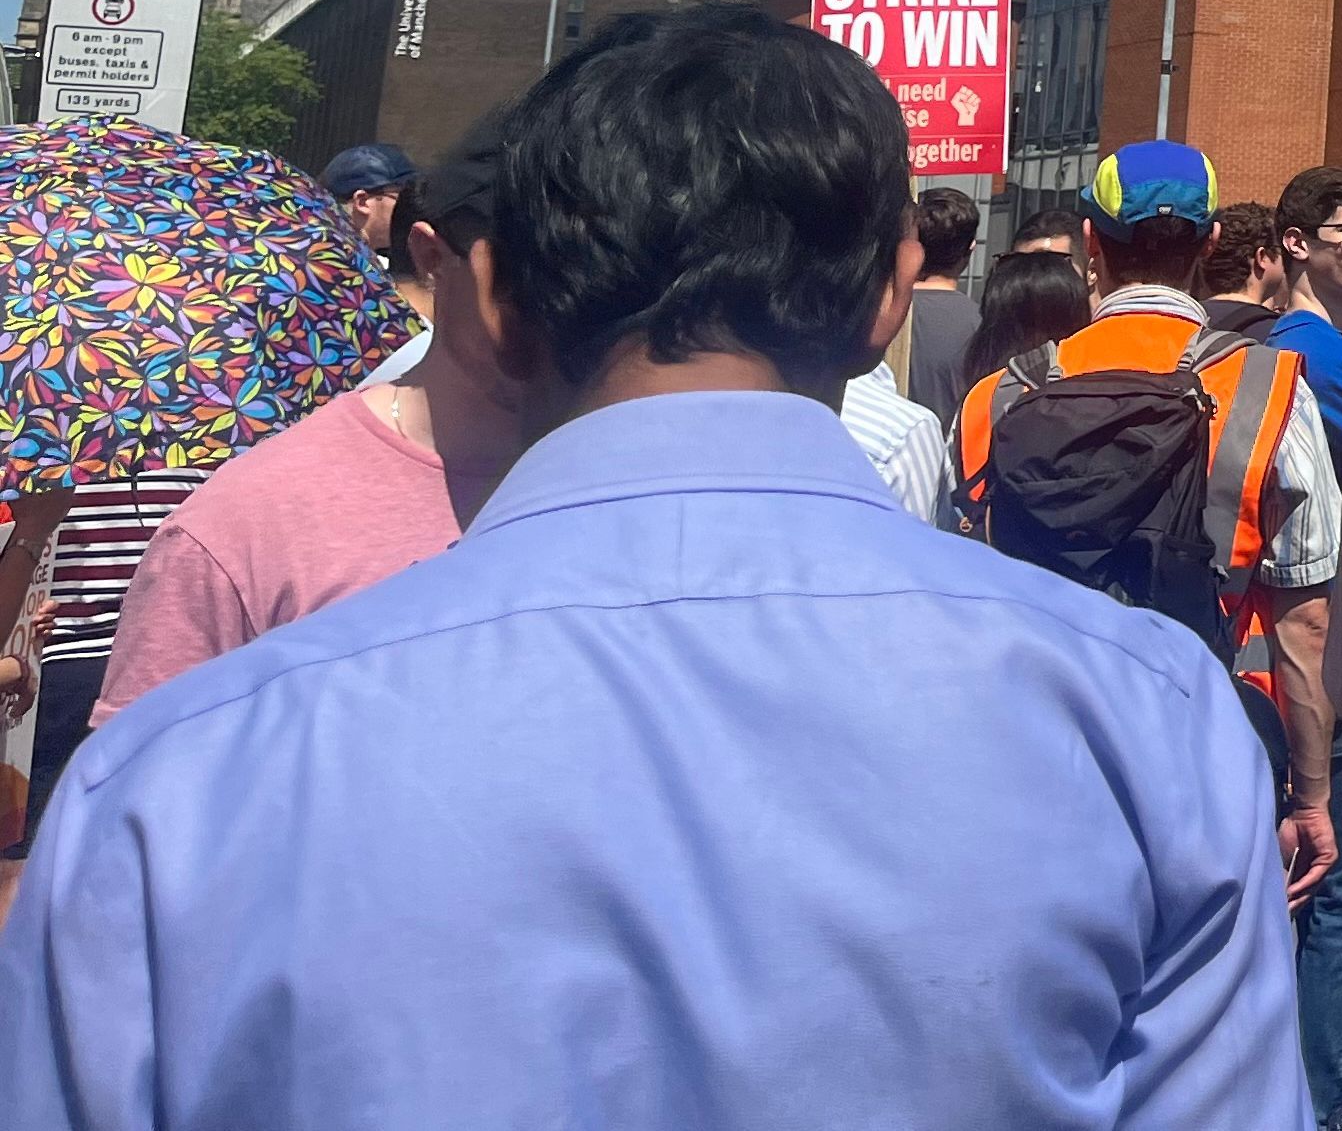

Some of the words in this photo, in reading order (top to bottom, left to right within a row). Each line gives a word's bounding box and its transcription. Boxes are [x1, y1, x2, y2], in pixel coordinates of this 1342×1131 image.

[902, 10, 998, 67] WIN
[84, 46, 127, 57] except
[105, 58, 136, 69] taxis
[141, 60, 149, 69] &
[53, 68, 97, 79] permit
[101, 70, 150, 82] holders
[898, 77, 946, 103] need
[67, 94, 90, 106] 135
[94, 96, 130, 108] yards
[908, 137, 983, 168] ogether
